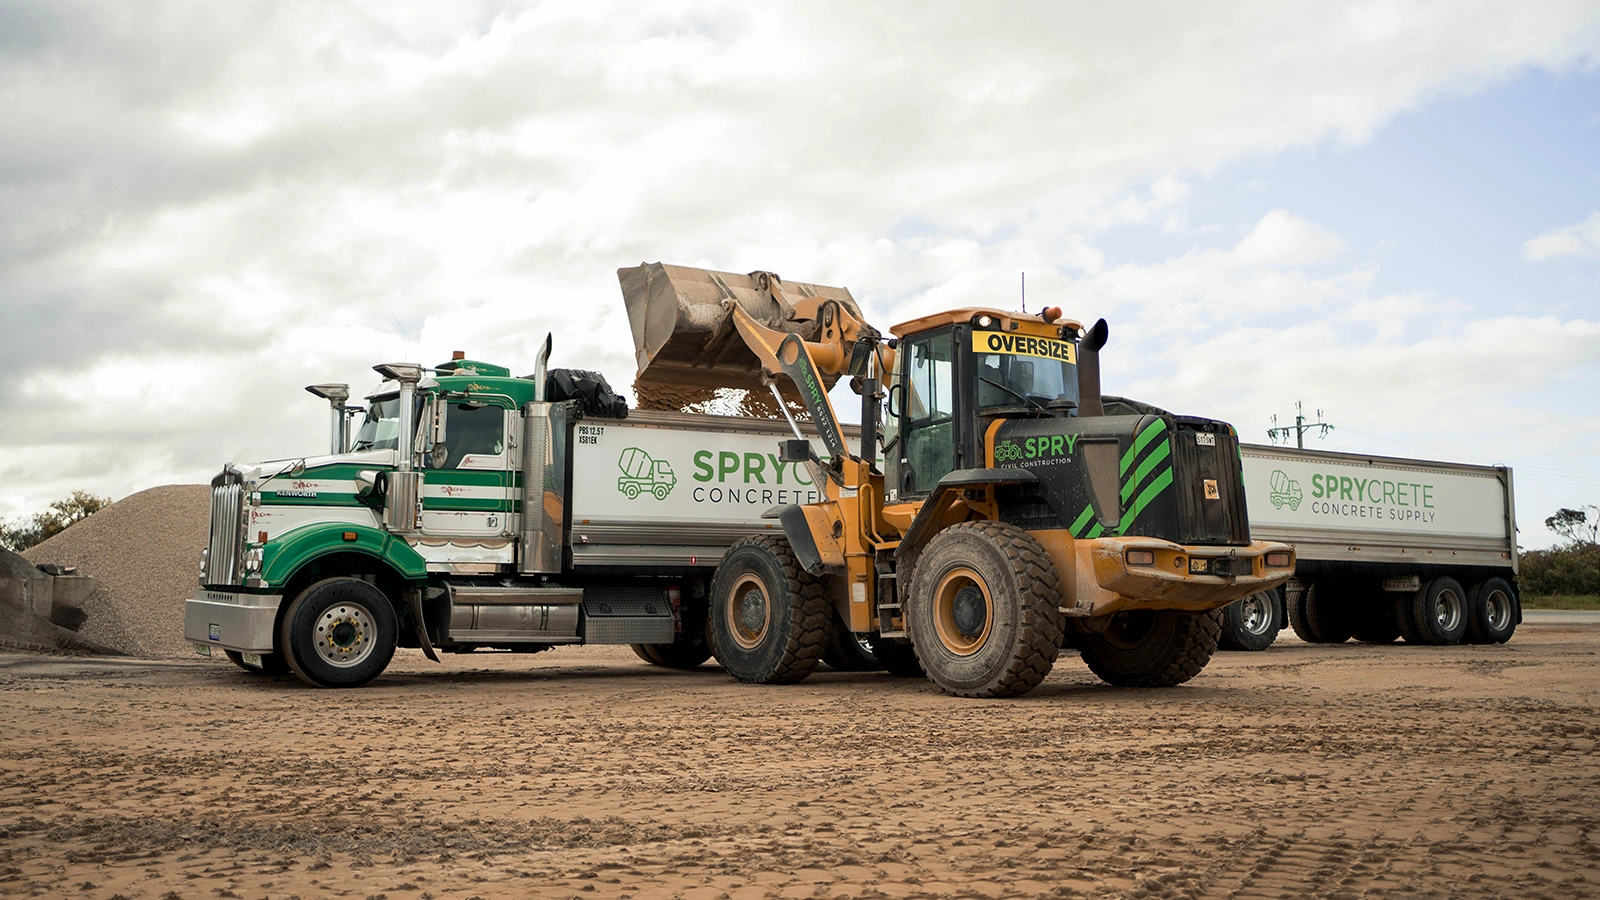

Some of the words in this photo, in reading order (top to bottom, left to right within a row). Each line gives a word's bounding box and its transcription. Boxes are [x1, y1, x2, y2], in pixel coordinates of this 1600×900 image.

[987, 334, 1069, 361] OVERSIZE
[805, 374, 823, 405] SPRY
[578, 426, 589, 435] PBS
[816, 405, 828, 426] 8532
[826, 428, 836, 447] 1214
[1025, 433, 1079, 459] SPRY
[1020, 458, 1072, 469] CONSTRUCTION
[276, 490, 317, 498] KENWORTH
[692, 487, 817, 505] CONCRETE
[1311, 473, 1435, 509] SPRYCRETE
[1311, 501, 1383, 519] CONCRETE
[1389, 508, 1436, 523] SUPPLY
